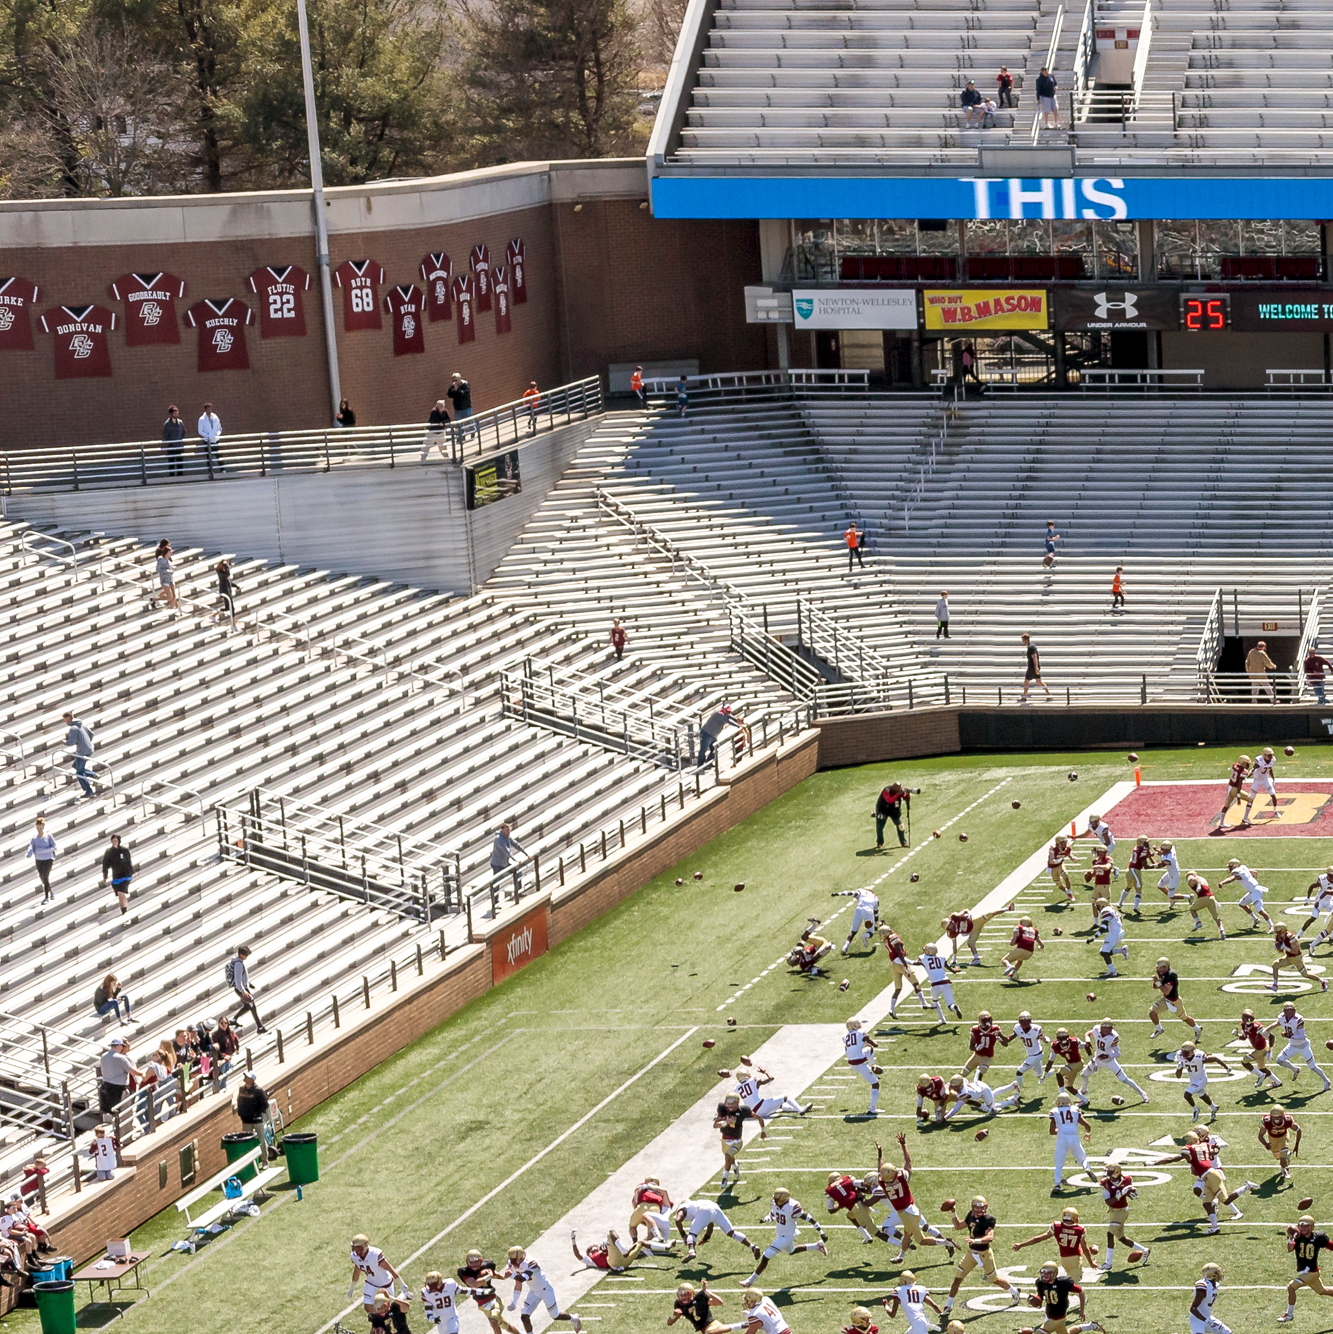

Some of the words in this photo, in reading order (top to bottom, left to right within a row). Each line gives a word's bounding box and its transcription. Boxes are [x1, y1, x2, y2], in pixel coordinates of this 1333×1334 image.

[958, 179, 1127, 219] THIS
[351, 277, 371, 287] RUTH
[267, 283, 295, 295] FLUTIE
[128, 290, 171, 302] GOODREAULT
[351, 288, 373, 312] 68
[818, 298, 913, 306] NEWTON-WELLESLEY
[927, 296, 946, 304] WHO
[947, 295, 963, 304] BUT
[269, 294, 295, 318] 22
[819, 307, 863, 315] HOSPITAL
[1259, 304, 1319, 319] WELCOME
[1187, 301, 1223, 328] 25
[56, 322, 103, 335] DONOVAN
[205, 317, 238, 328] KUECHLY
[507, 926, 533, 965] xfinity
[1059, 1234, 1077, 1247] 37
